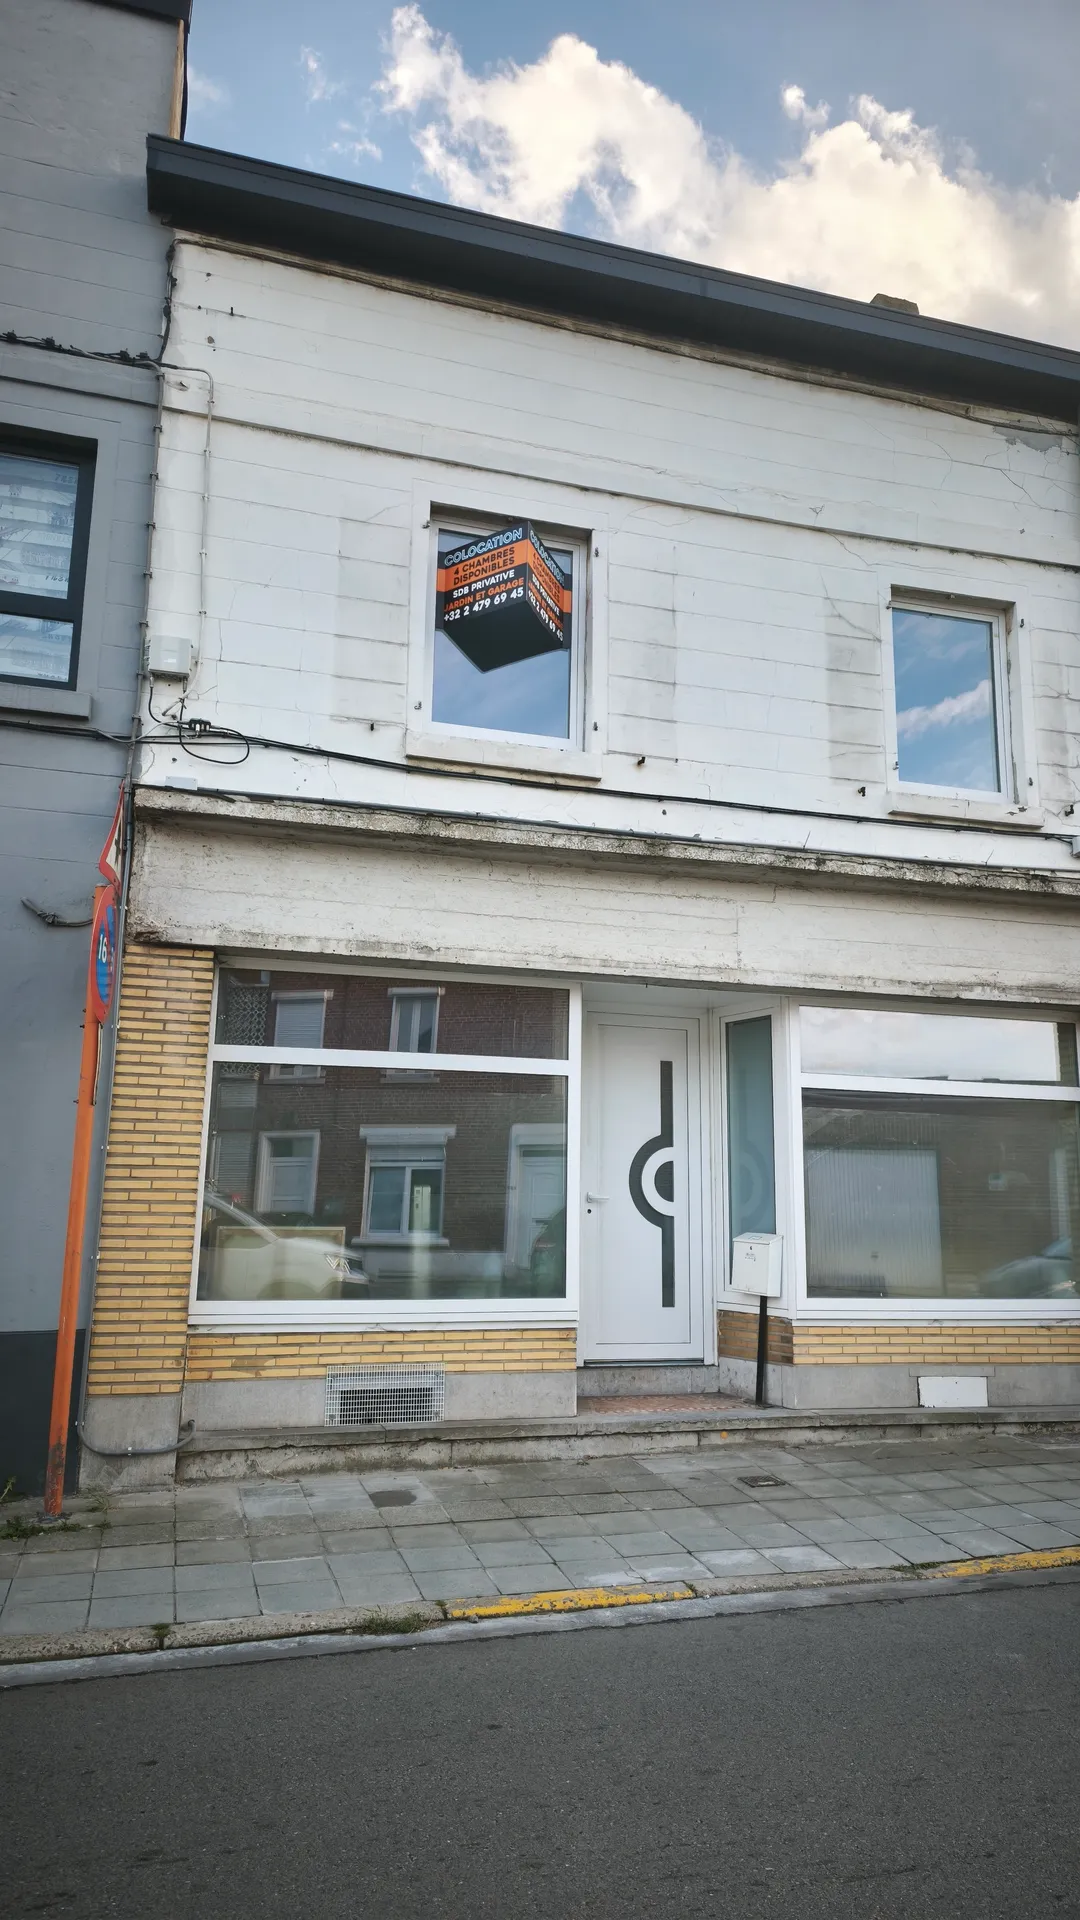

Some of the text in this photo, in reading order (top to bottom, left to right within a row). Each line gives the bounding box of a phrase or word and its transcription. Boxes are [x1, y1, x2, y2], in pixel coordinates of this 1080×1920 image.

[444, 527, 523, 567] COLOCATION
[453, 546, 515, 576] 4 CHAMBRES
[530, 529, 565, 587] COLOCATION
[452, 569, 515, 599] SDB PRIVATIVE
[453, 556, 515, 586] DISPONIBLES
[444, 577, 525, 612] JARDIN ET GARAGE
[444, 587, 524, 622] +32 2 479 69 45
[98, 933, 108, 964] 16
